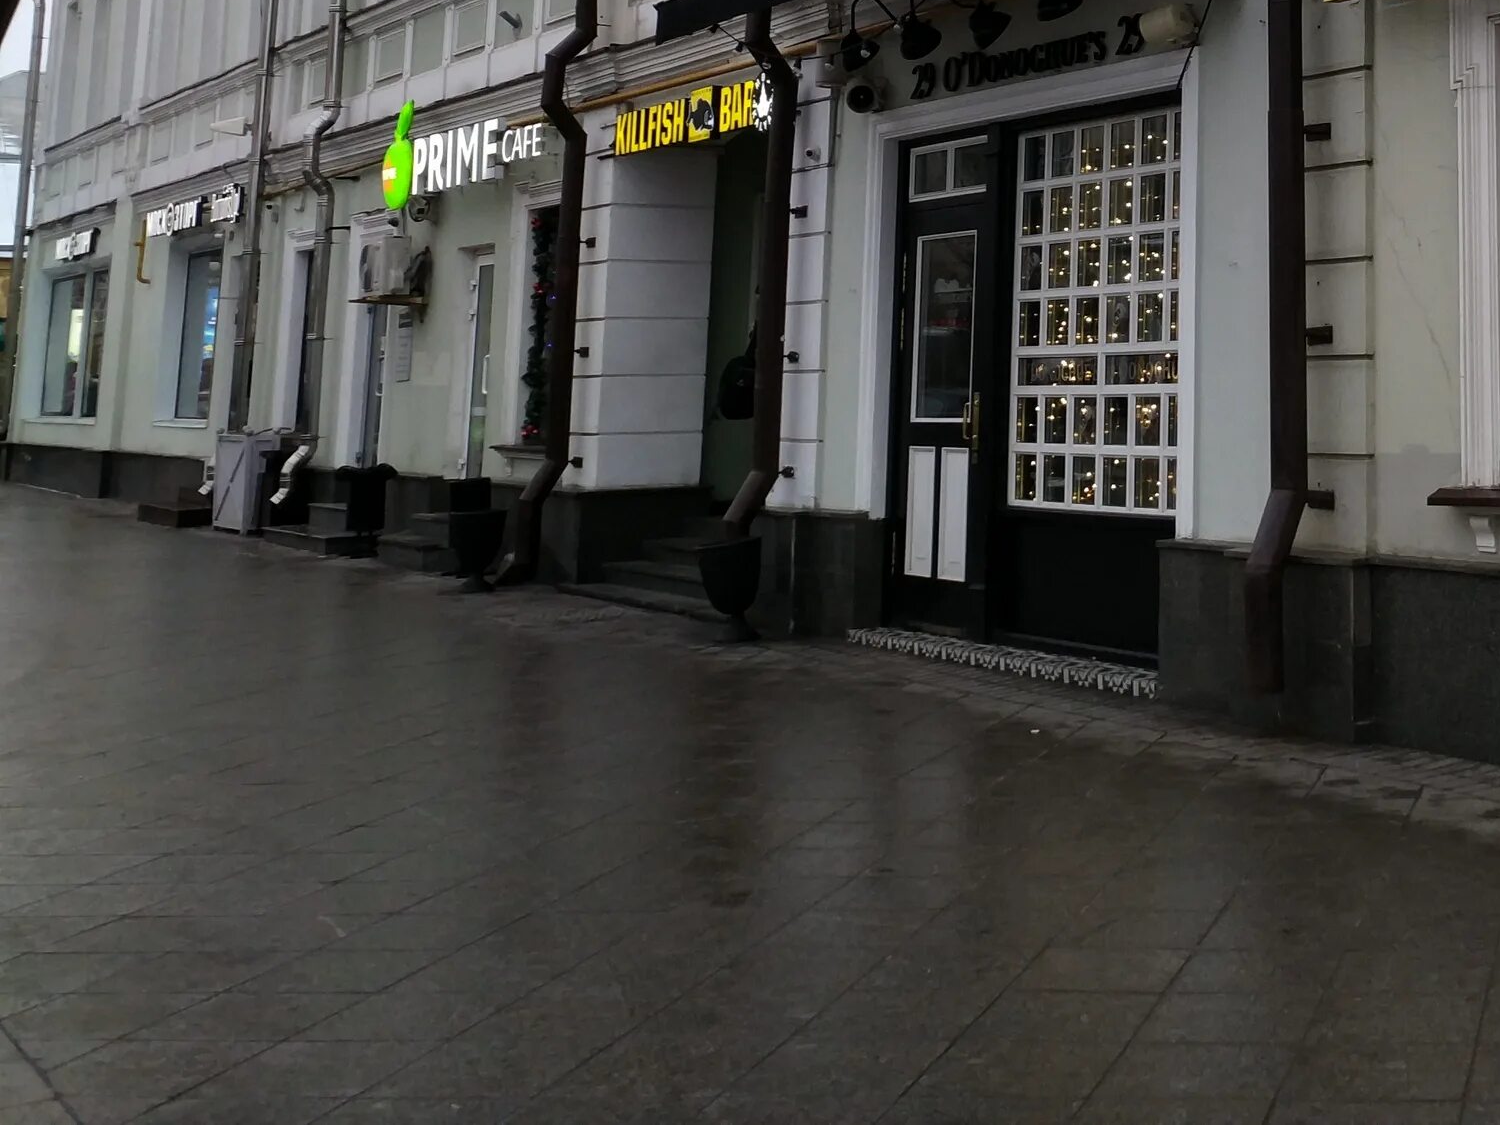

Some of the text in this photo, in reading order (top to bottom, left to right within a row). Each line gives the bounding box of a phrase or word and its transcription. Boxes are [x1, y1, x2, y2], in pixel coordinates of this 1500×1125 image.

[411, 117, 543, 196] PRIME CAFE
[615, 80, 756, 156] KILLFISH BAR
